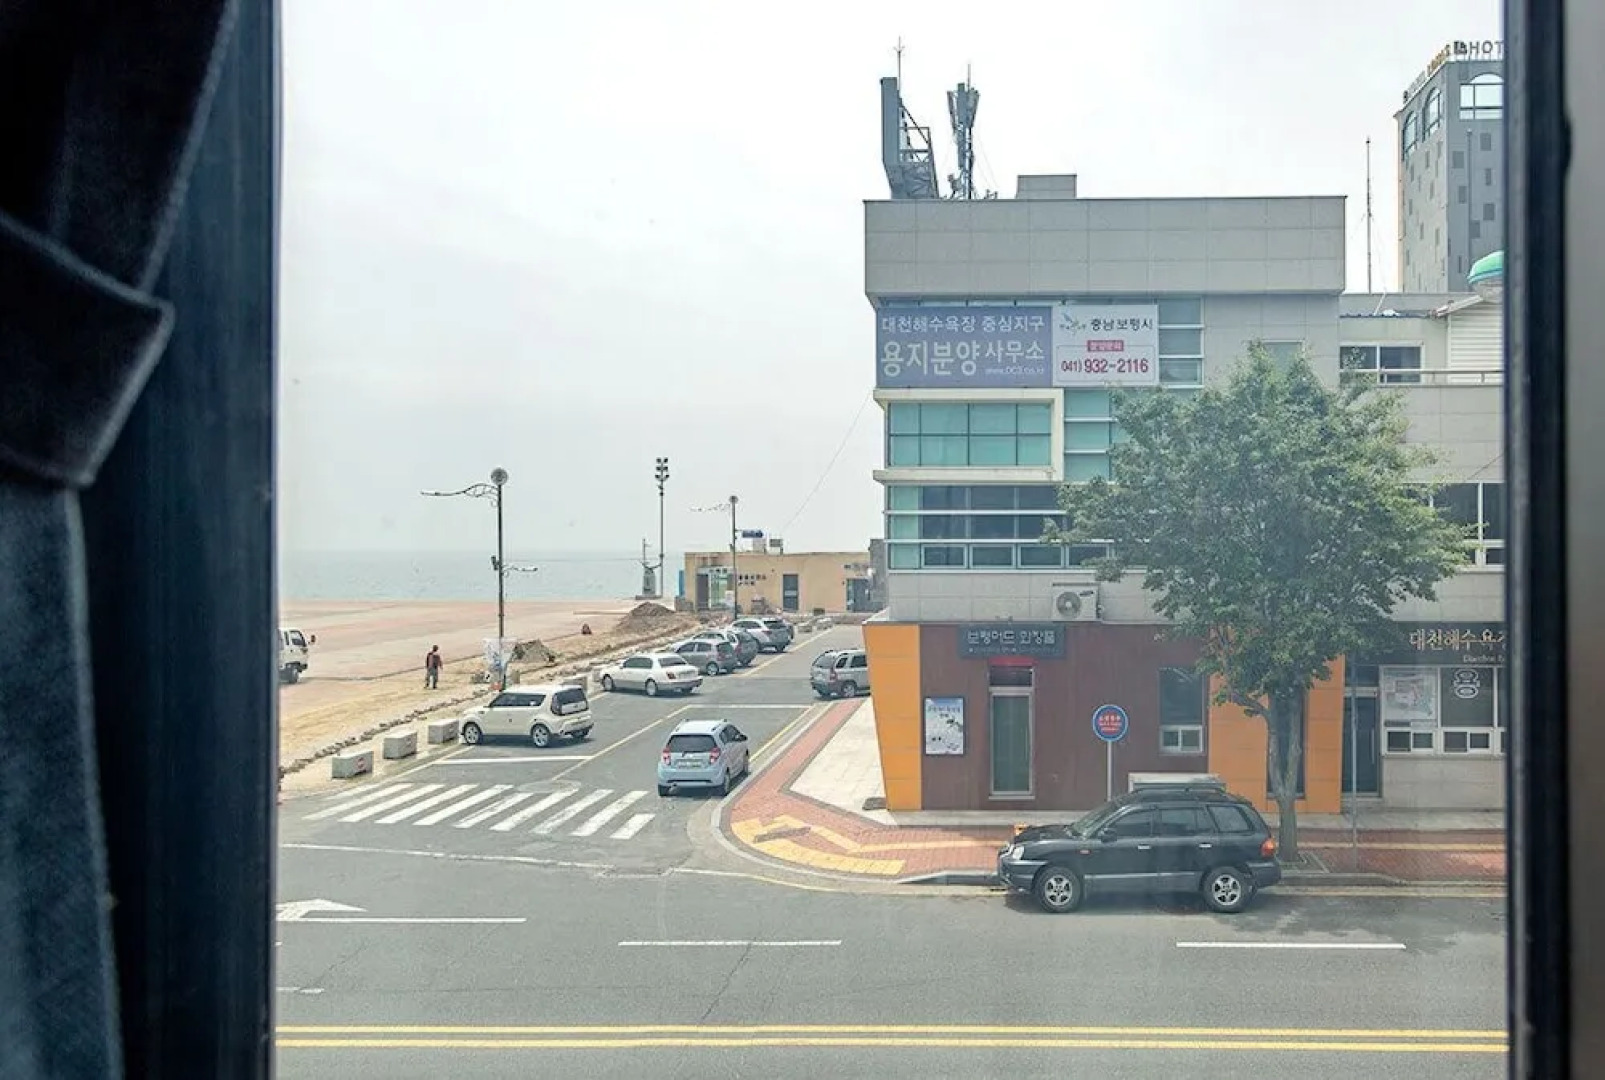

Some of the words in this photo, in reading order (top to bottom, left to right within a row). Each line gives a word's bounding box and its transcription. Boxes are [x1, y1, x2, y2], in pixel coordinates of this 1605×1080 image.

[882, 315, 976, 333] 대천해수욕장
[982, 315, 1045, 332] 중심지구
[881, 340, 980, 377] 용지분양
[985, 340, 1045, 363] 사무소
[1084, 358, 1149, 373] 932-2116
